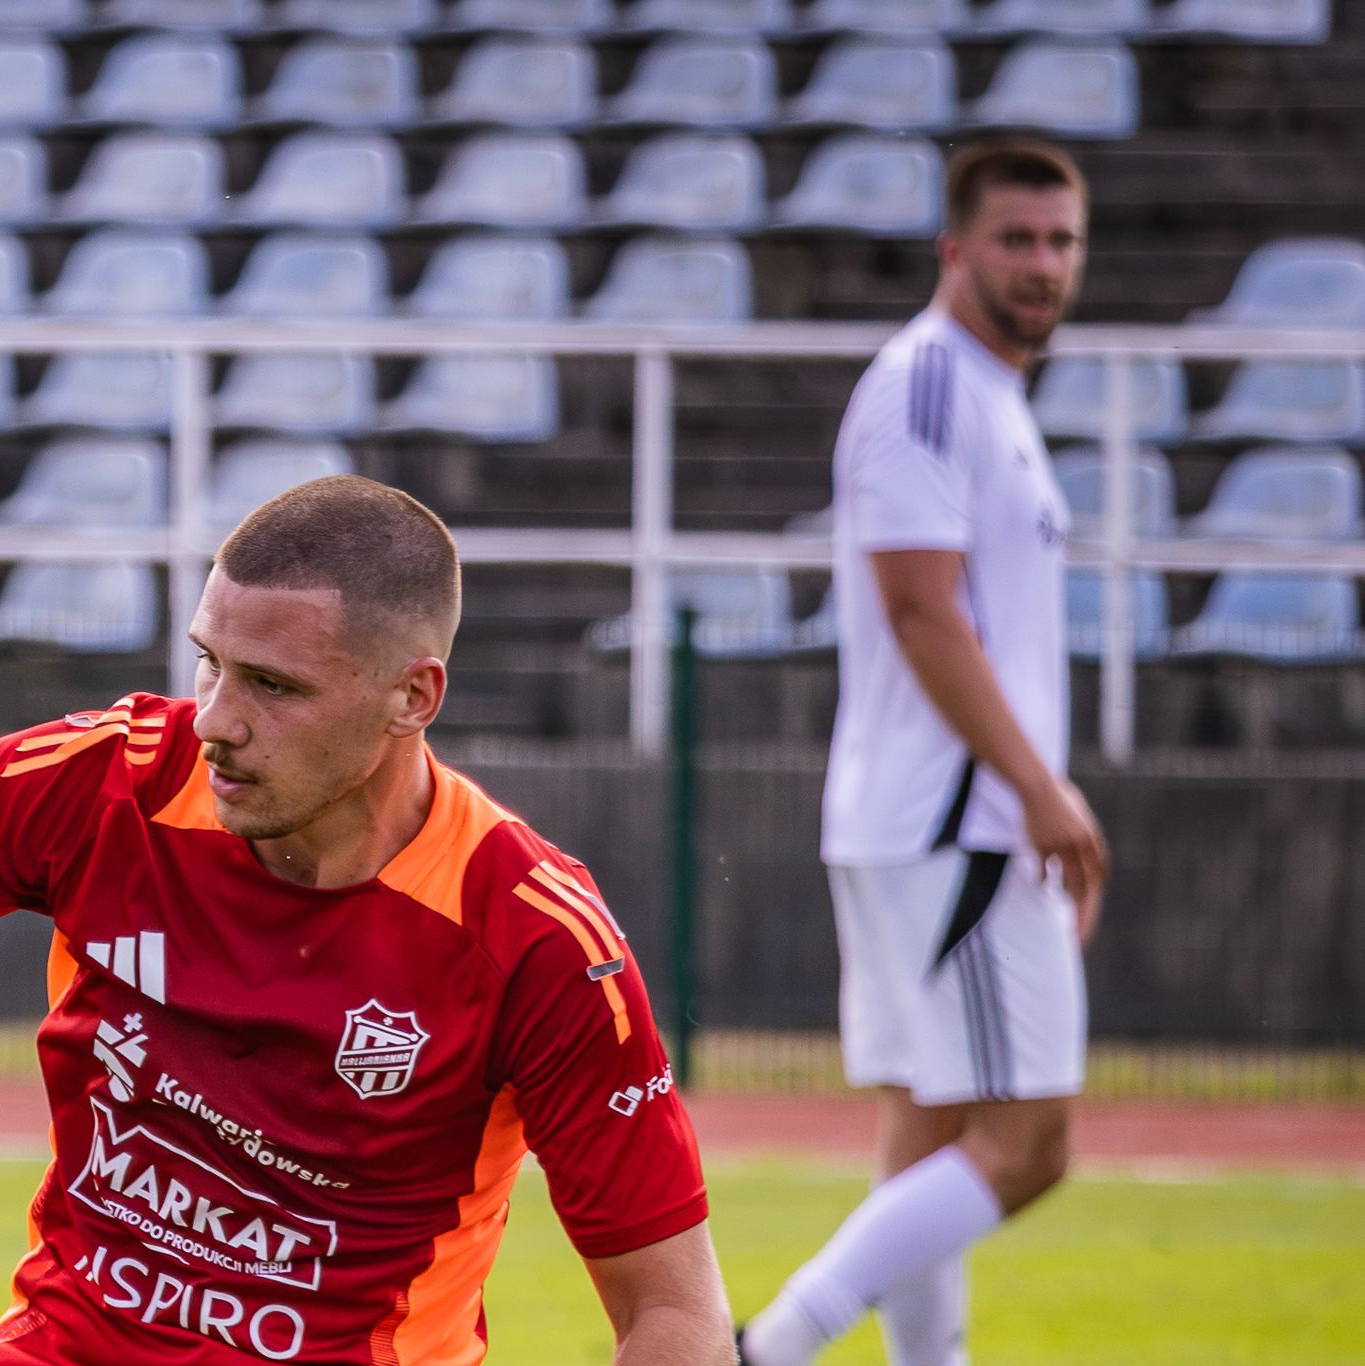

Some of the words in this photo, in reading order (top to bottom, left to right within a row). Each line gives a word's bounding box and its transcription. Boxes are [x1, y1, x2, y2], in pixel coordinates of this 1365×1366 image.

[155, 1072, 269, 1140] Kalwari
[91, 1135, 311, 1262] MARKAT
[141, 1218, 163, 1240] DO
[164, 1230, 242, 1272] PRODUKCJI
[244, 1261, 292, 1275] MEBLI
